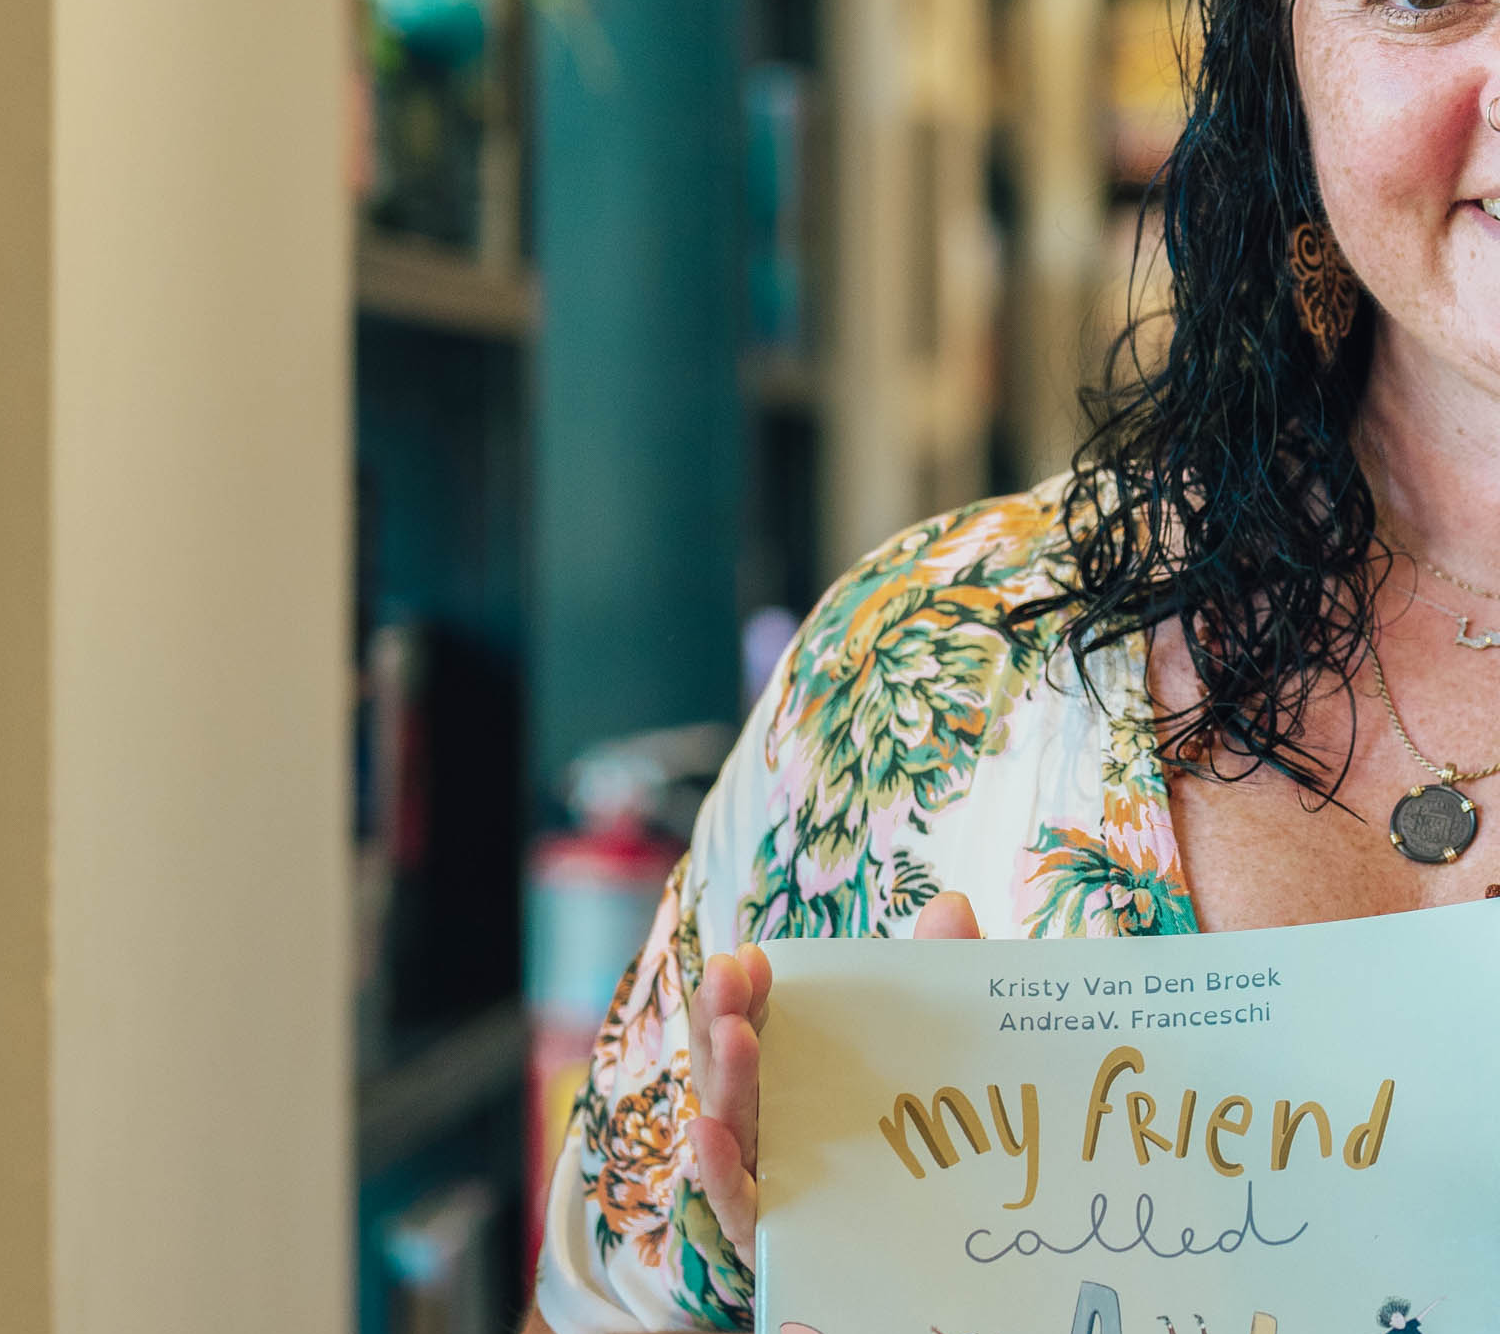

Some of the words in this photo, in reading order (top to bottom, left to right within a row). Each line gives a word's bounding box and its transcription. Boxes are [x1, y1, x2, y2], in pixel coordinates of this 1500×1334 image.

[989, 976, 1070, 1001] Kristy
[1083, 975, 1133, 997] Van
[1144, 972, 1194, 995] Den
[1206, 968, 1282, 992] Broek
[1130, 1003, 1271, 1029] Franceschi
[878, 1083, 1041, 1210] my
[964, 1180, 1308, 1264] called
